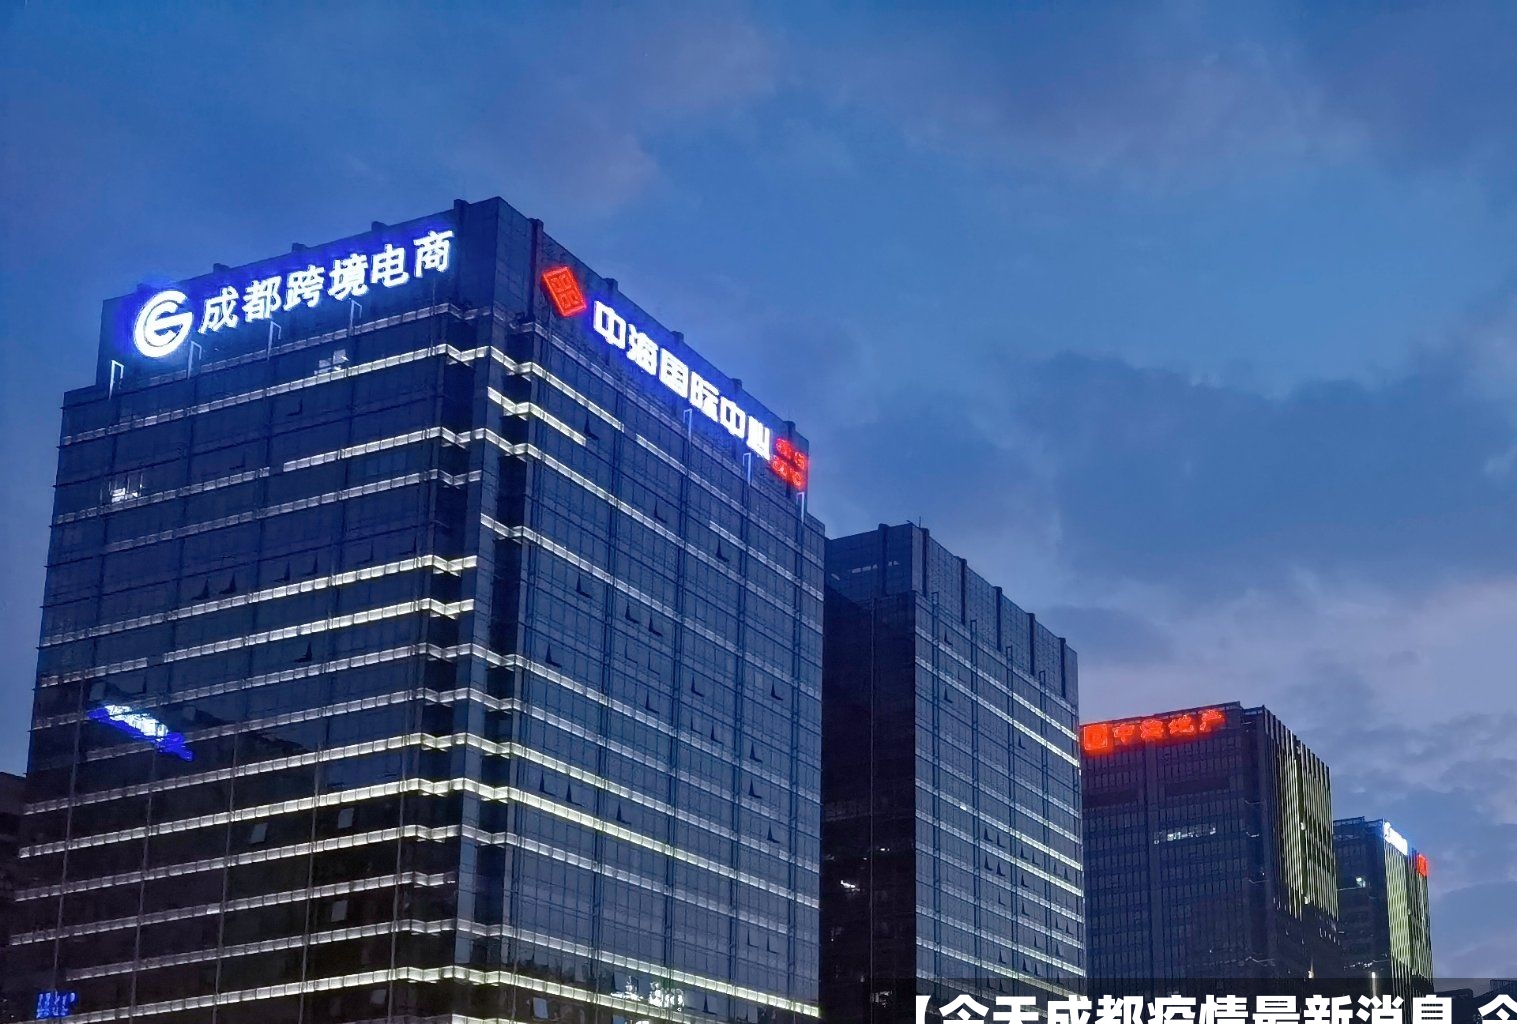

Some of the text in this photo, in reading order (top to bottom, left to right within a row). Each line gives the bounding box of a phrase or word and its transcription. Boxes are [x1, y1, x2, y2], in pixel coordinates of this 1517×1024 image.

[198, 230, 453, 333] 成都跨境电商
[592, 300, 771, 461] 中海国际中心
